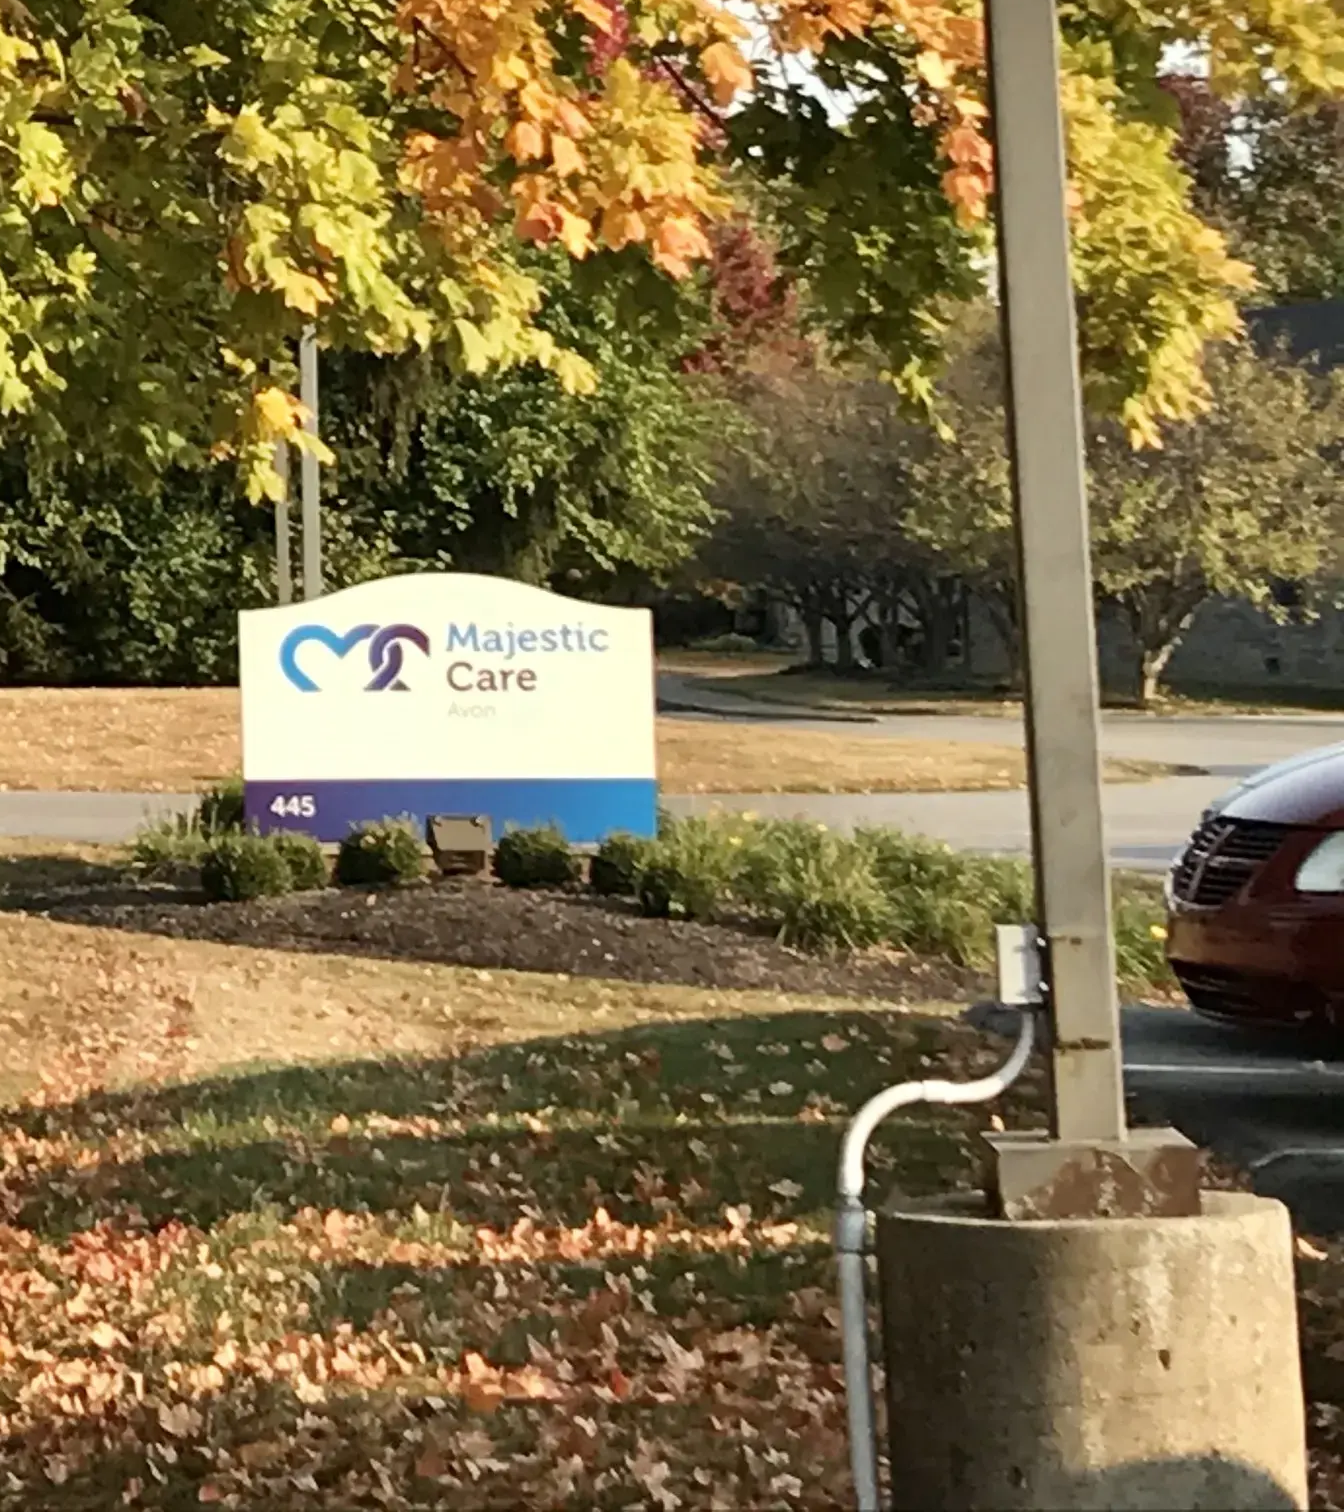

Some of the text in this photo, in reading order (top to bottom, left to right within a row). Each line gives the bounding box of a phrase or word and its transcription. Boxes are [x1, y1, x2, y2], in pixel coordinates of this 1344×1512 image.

[445, 621, 610, 659] Majestic
[445, 661, 538, 692] Care
[447, 701, 496, 719] Avon
[270, 794, 316, 818] 445
